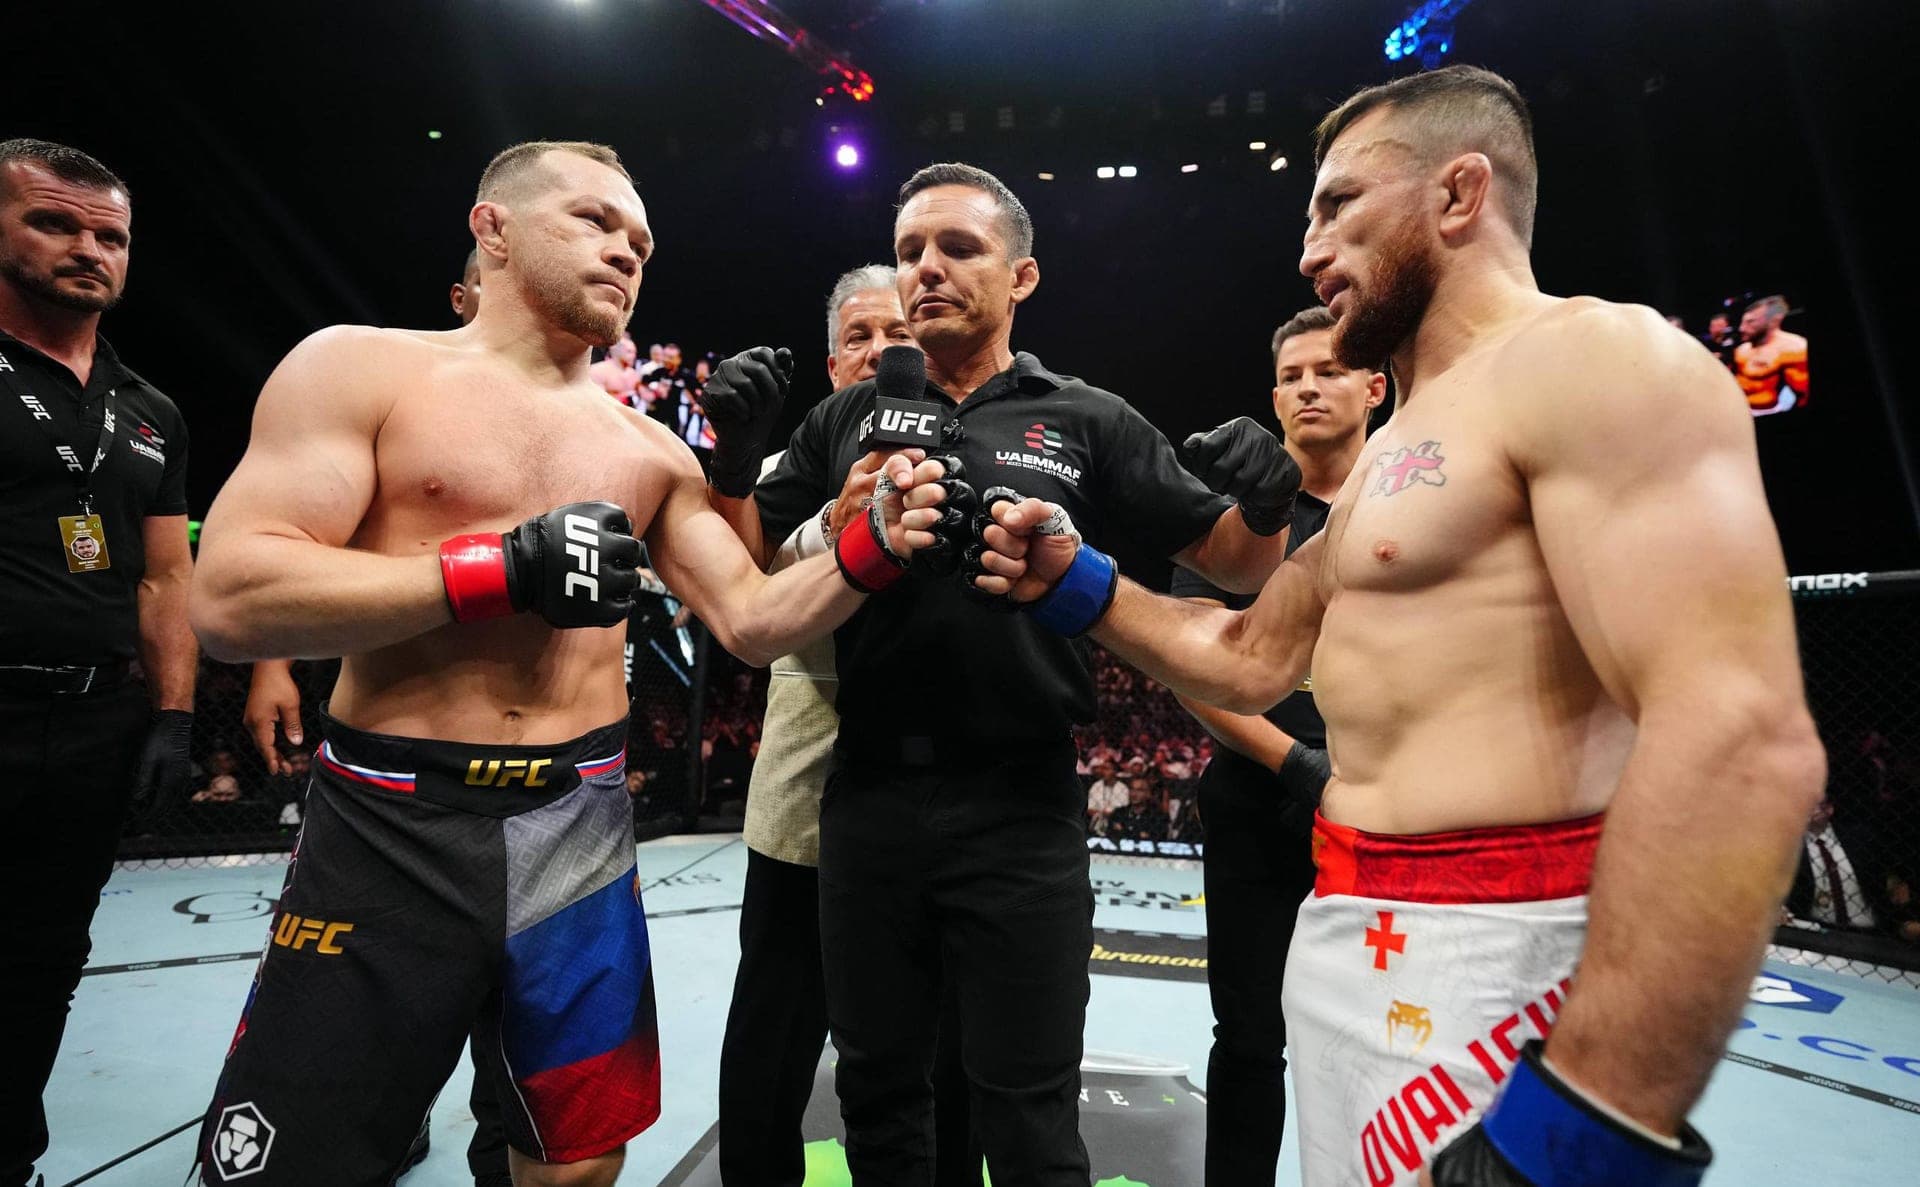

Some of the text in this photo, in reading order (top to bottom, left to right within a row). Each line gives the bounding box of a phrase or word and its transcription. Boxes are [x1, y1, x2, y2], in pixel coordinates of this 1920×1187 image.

[20, 395, 52, 421] UFC
[104, 408, 116, 434] UFC
[859, 409, 875, 442] UFC
[880, 409, 937, 436] UFC
[56, 445, 84, 472] UFC
[995, 451, 1082, 479] UAEMMAF
[1022, 463, 1043, 472] MARTIAL
[1044, 468, 1056, 476] ARTS
[564, 513, 599, 602] UFC
[464, 759, 551, 787] UFC
[274, 912, 354, 955] UFC
